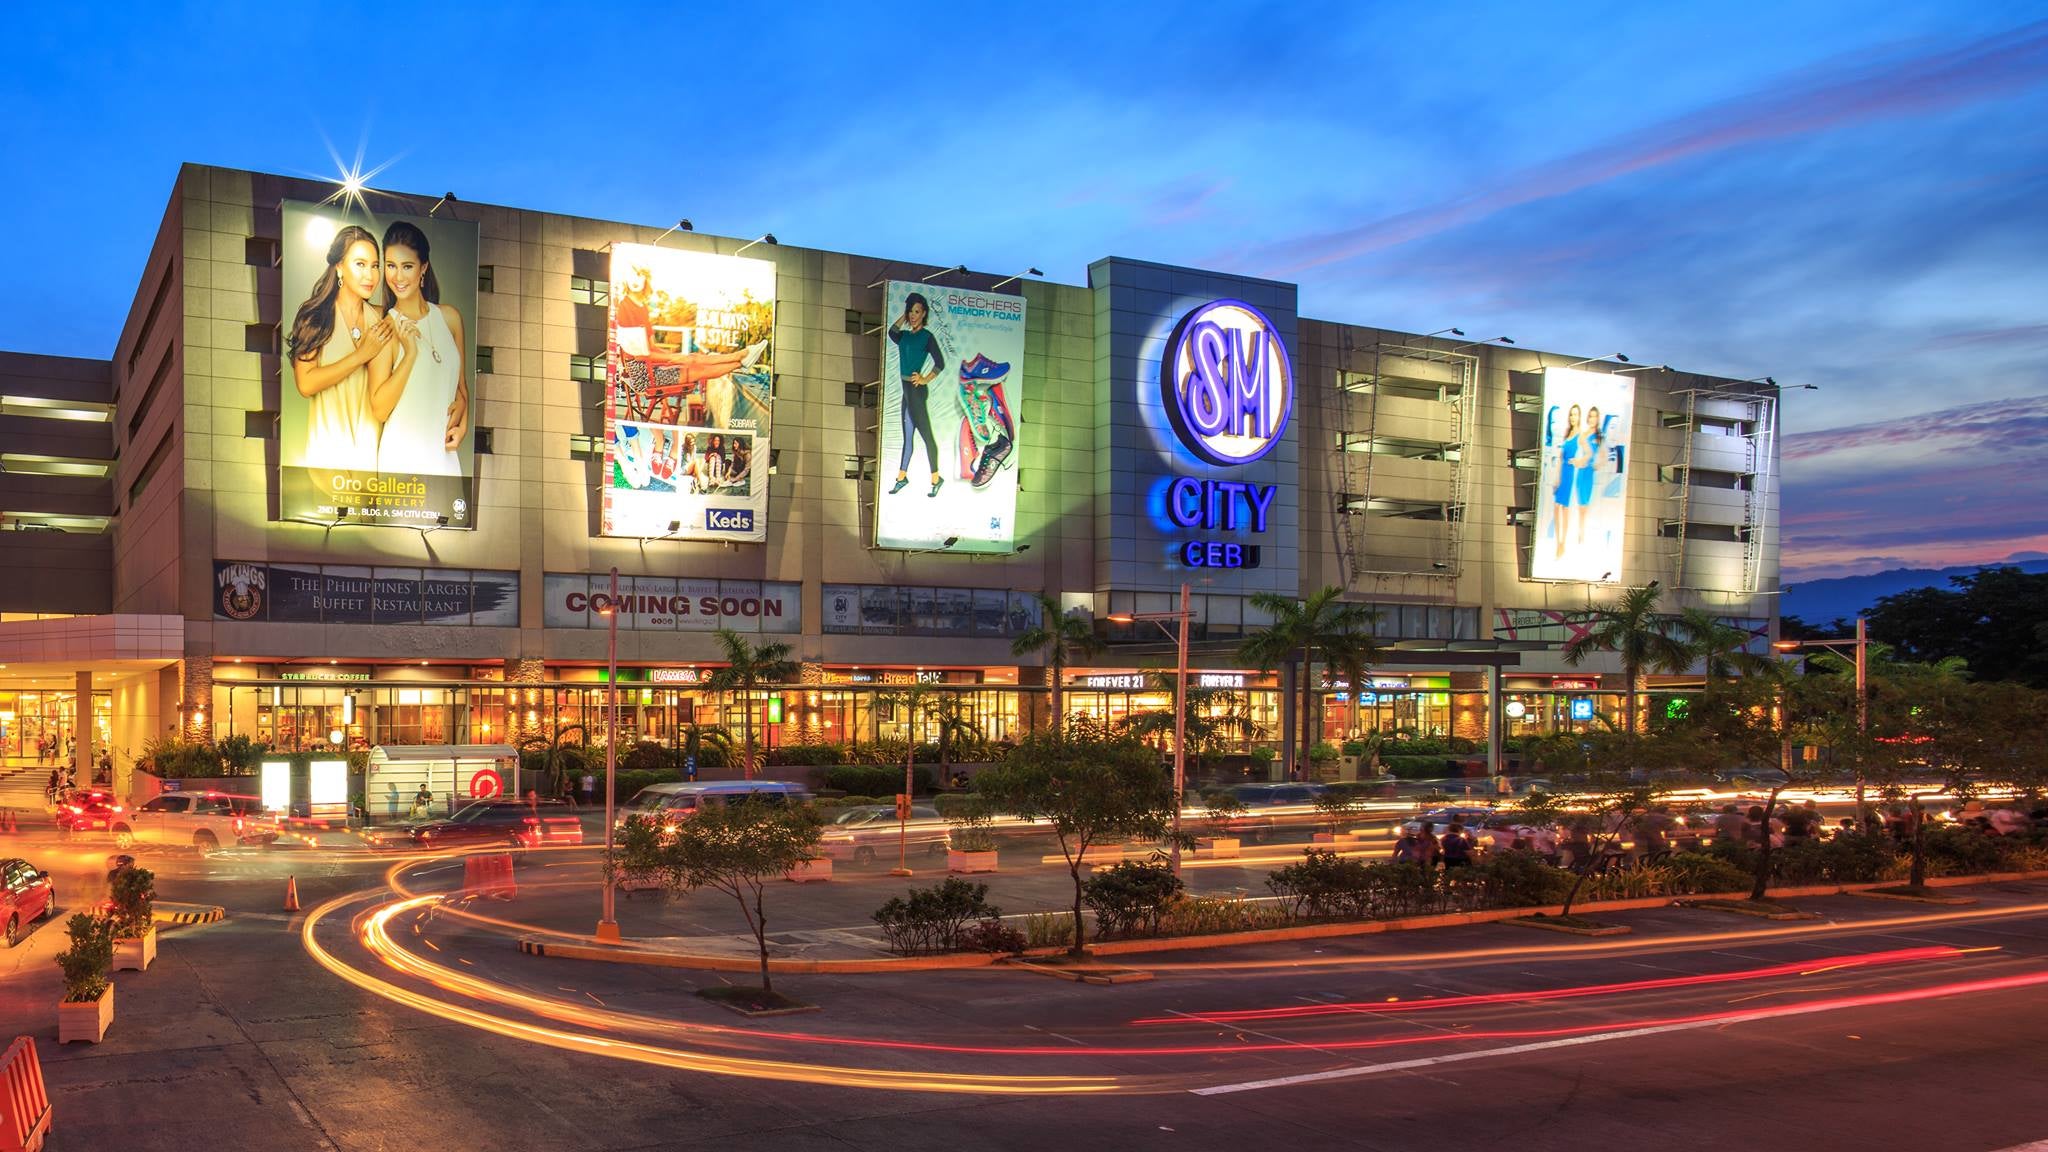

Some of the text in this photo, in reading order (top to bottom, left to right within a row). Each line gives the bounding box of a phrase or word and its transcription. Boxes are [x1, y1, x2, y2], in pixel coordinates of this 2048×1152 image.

[948, 294, 1021, 312] SKECHERS
[948, 306, 1021, 321] MEMORY FOAM
[1186, 320, 1271, 439] SM
[332, 475, 426, 495] Oro Galleria
[332, 495, 425, 507] FINE JEWELRY
[1170, 475, 1277, 532] CITY
[335, 506, 357, 515] LEL
[709, 511, 750, 528] Keds
[1182, 541, 1260, 569] CEBU
[218, 564, 266, 591] VIKINGS
[290, 577, 320, 592] THE
[418, 580, 478, 596] LARGEST
[313, 595, 462, 612] BUFFET RESTAURANT
[566, 592, 782, 617] COMING SOON
[1087, 675, 1144, 688] FOREVER 21
[1200, 675, 1234, 688] FOREVER
